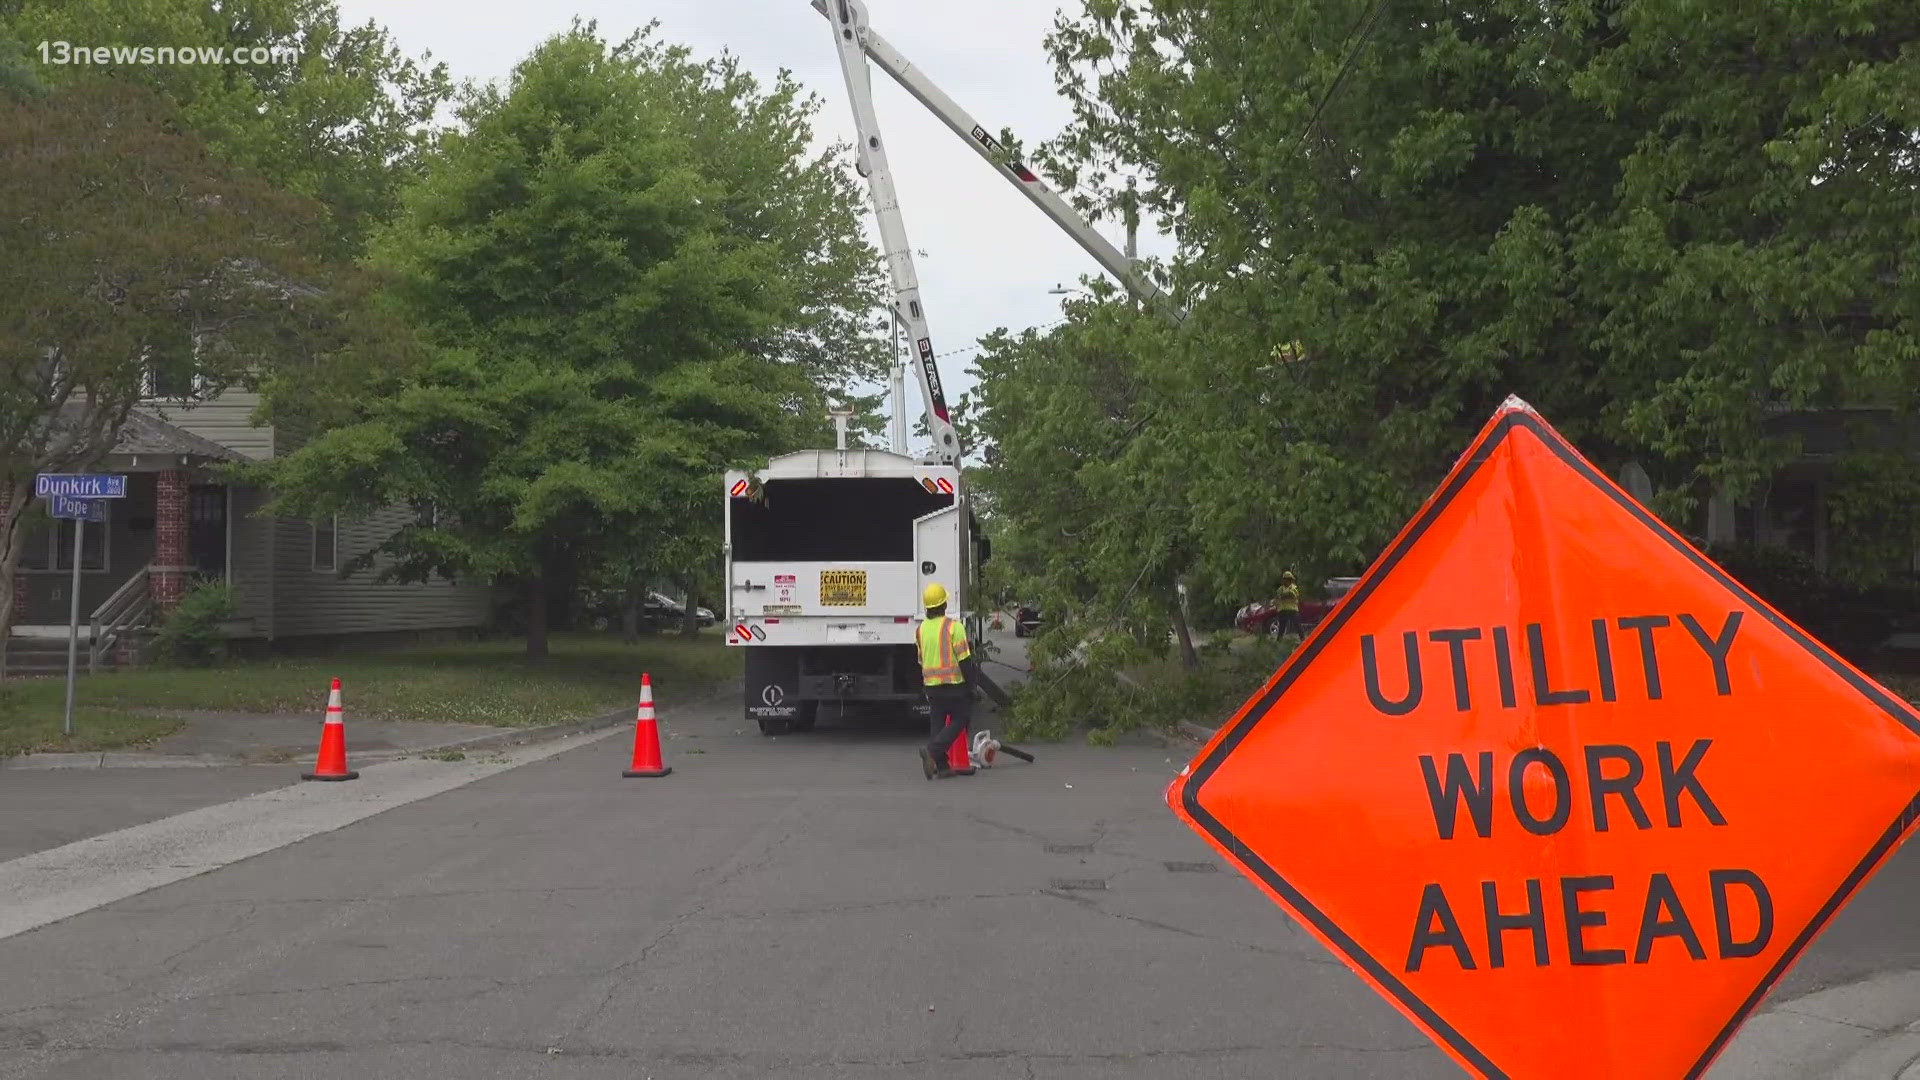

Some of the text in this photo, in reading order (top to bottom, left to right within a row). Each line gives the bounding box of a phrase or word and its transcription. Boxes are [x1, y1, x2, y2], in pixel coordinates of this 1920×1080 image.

[924, 355, 941, 400] TEREX
[40, 477, 119, 495] Dunkirk Ave
[59, 497, 88, 516] Pope
[824, 575, 863, 584] CAUTION
[1360, 611, 1744, 716] UTILITY
[1418, 739, 1728, 840] WORK
[1404, 869, 1774, 972] AHEAD
